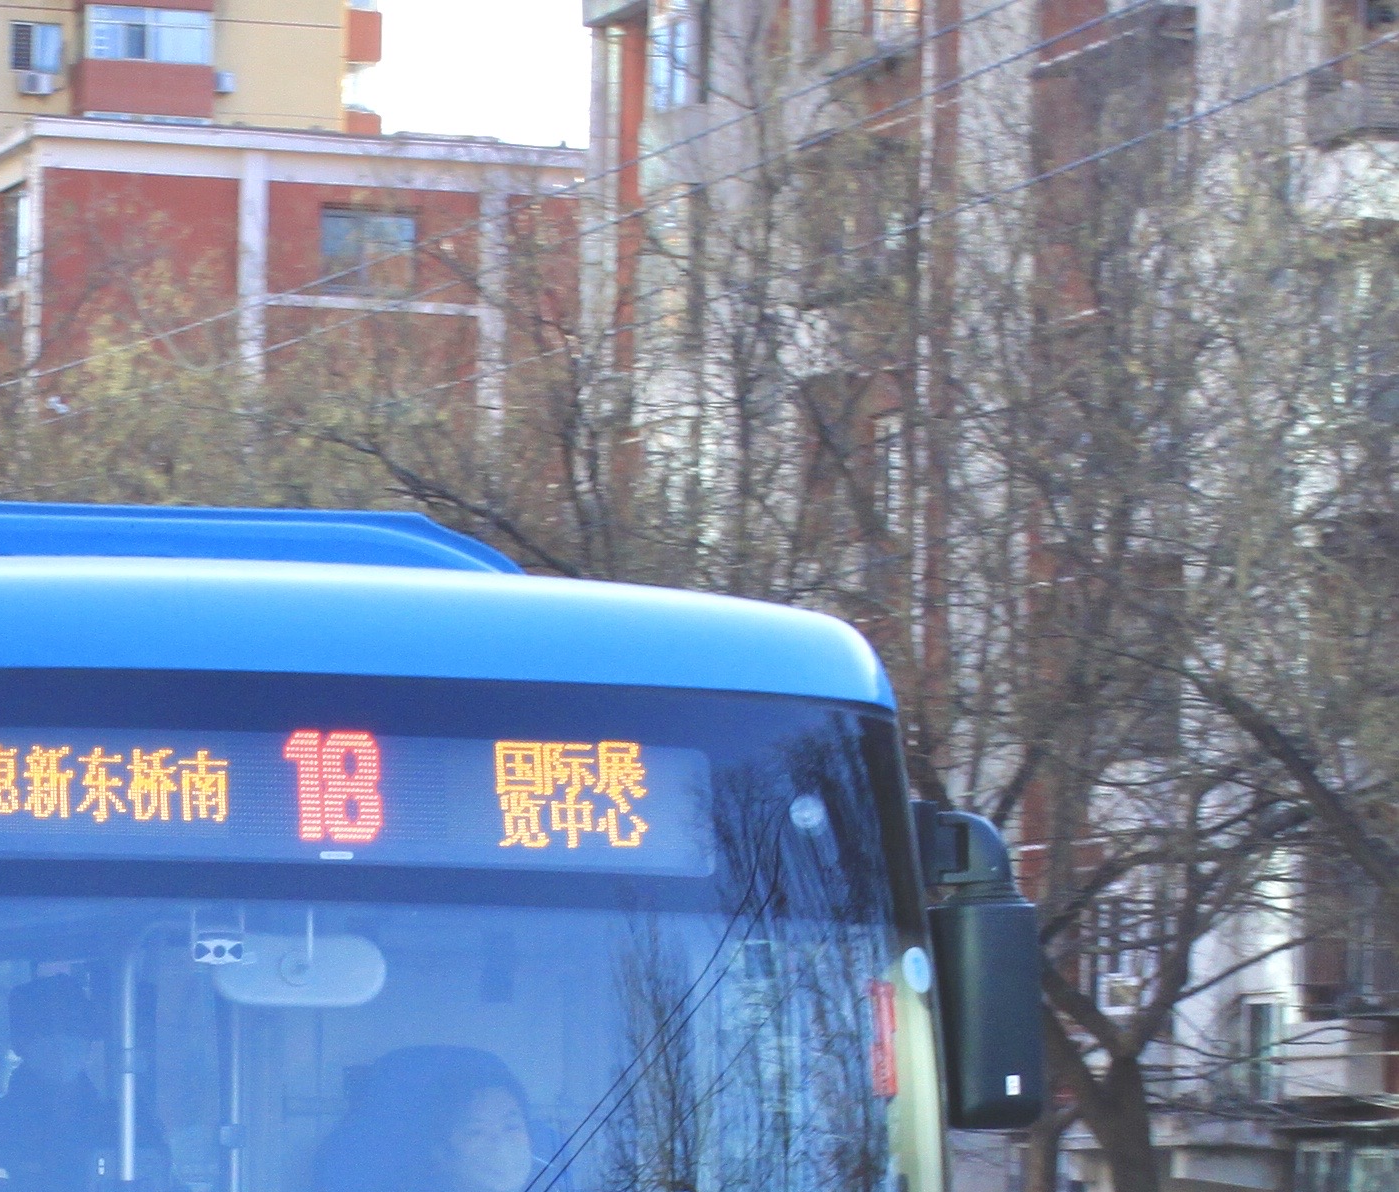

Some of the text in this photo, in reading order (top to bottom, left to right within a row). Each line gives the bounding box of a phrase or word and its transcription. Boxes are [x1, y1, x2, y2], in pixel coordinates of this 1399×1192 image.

[285, 729, 384, 842] 18
[494, 740, 646, 798] 国际展
[499, 792, 648, 849] 览中心
